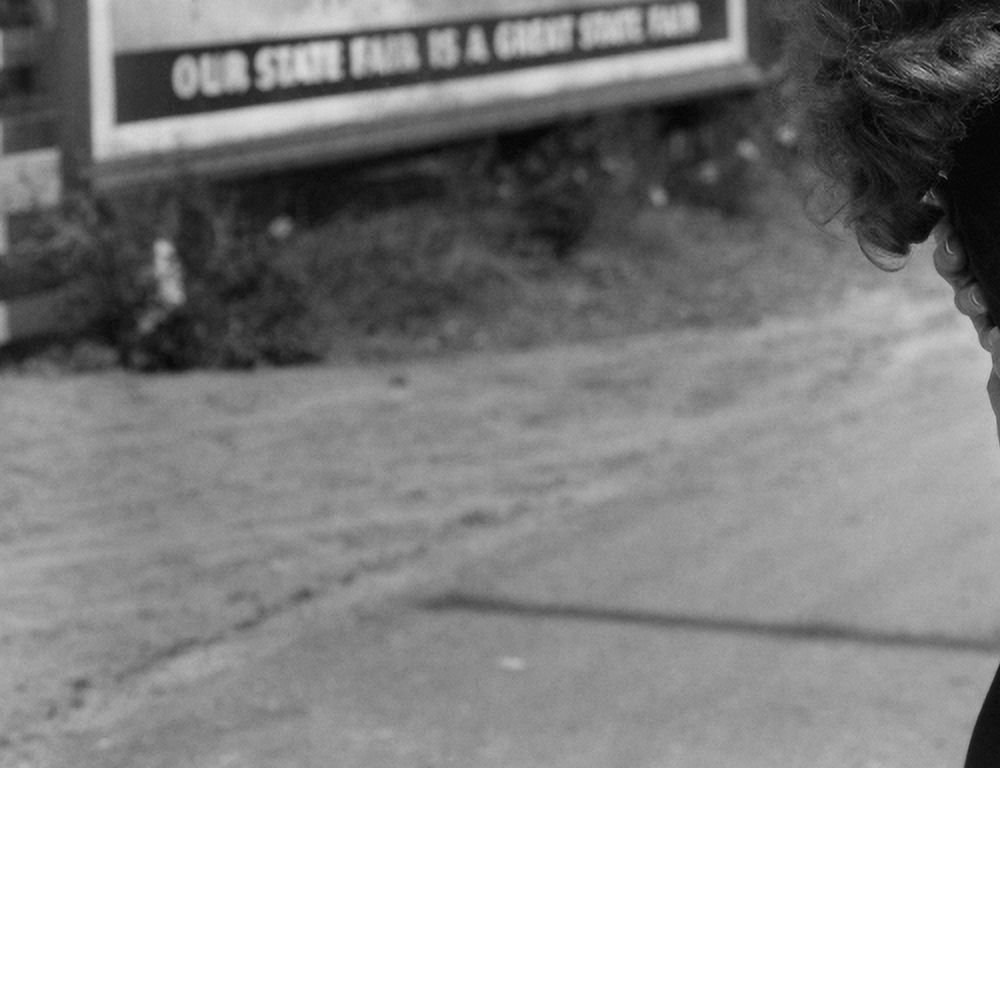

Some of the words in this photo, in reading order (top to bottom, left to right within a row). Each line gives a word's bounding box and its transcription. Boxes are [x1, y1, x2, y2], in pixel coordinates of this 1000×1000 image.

[171, 49, 250, 101] OUR
[253, 39, 344, 92] STATE
[349, 31, 421, 81] FAIR
[426, 26, 461, 70] IS
[464, 23, 491, 66] A
